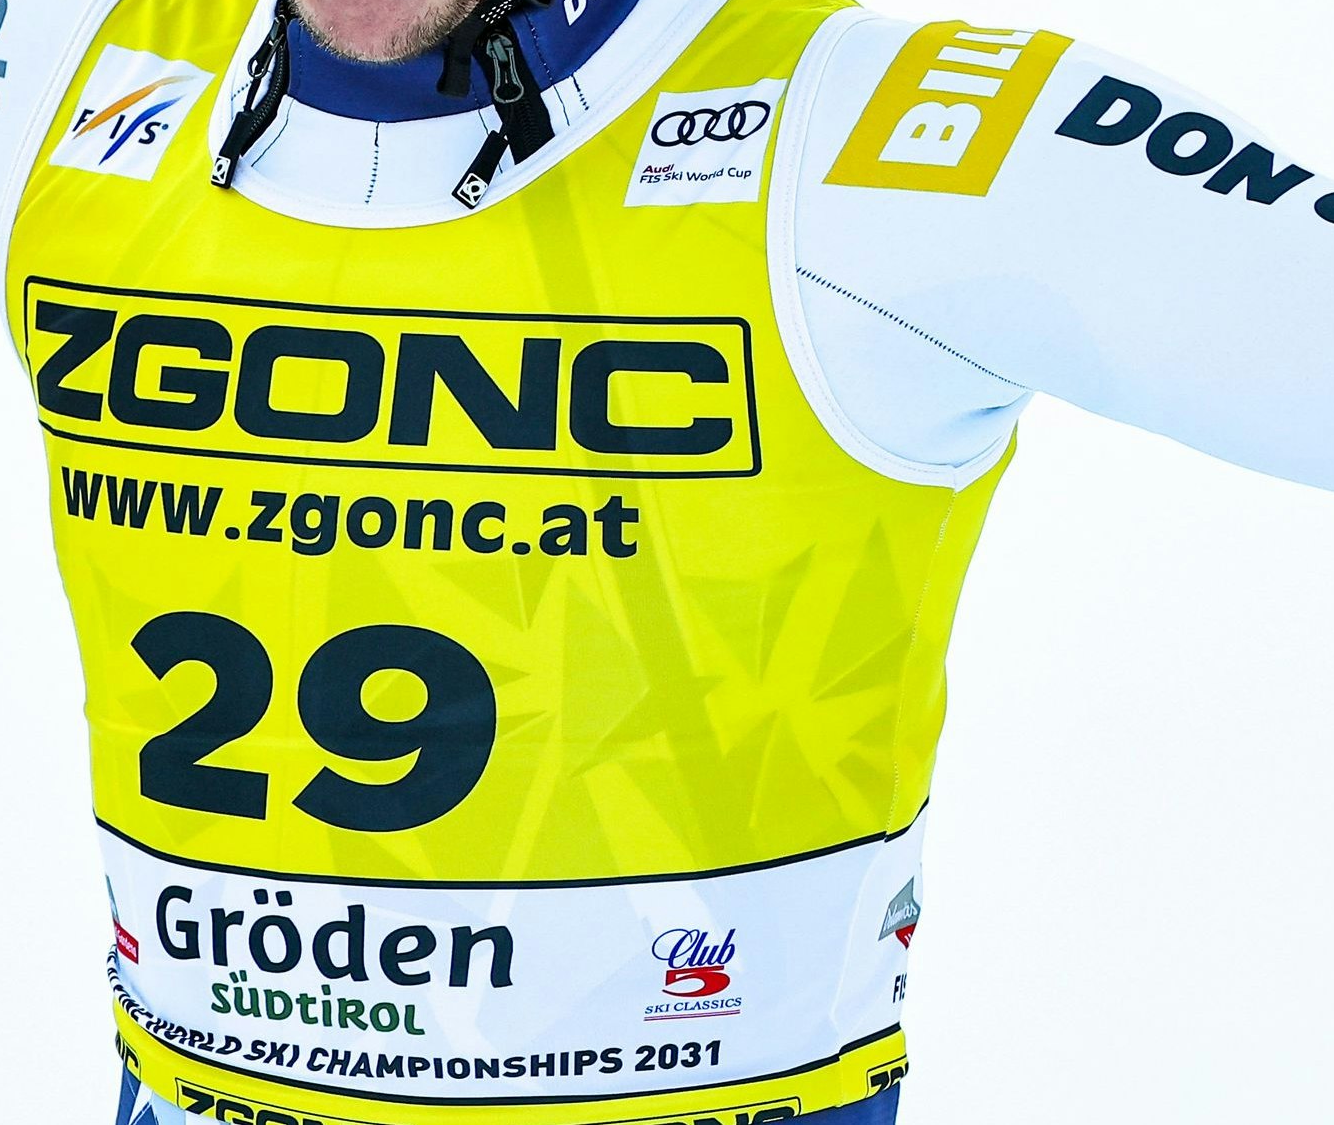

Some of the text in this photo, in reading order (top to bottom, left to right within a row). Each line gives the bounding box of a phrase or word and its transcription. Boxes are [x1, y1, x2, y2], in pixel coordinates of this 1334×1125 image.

[71, 107, 164, 145] FIS
[1054, 75, 1315, 205] DON
[639, 167, 752, 184] FIS Ski World Cup
[642, 164, 674, 174] Audi
[35, 300, 733, 456] ZGONC
[60, 465, 640, 559] www.zgonc.at
[129, 610, 498, 833] 29
[155, 884, 514, 989] Gröden
[652, 927, 737, 970] Club
[661, 965, 731, 997] 5
[644, 996, 743, 1015] SKI CLASSICS
[243, 1038, 301, 1068] SKI
[306, 1046, 623, 1080] CHAMPIONSHIPS
[634, 1039, 722, 1072] 2031
